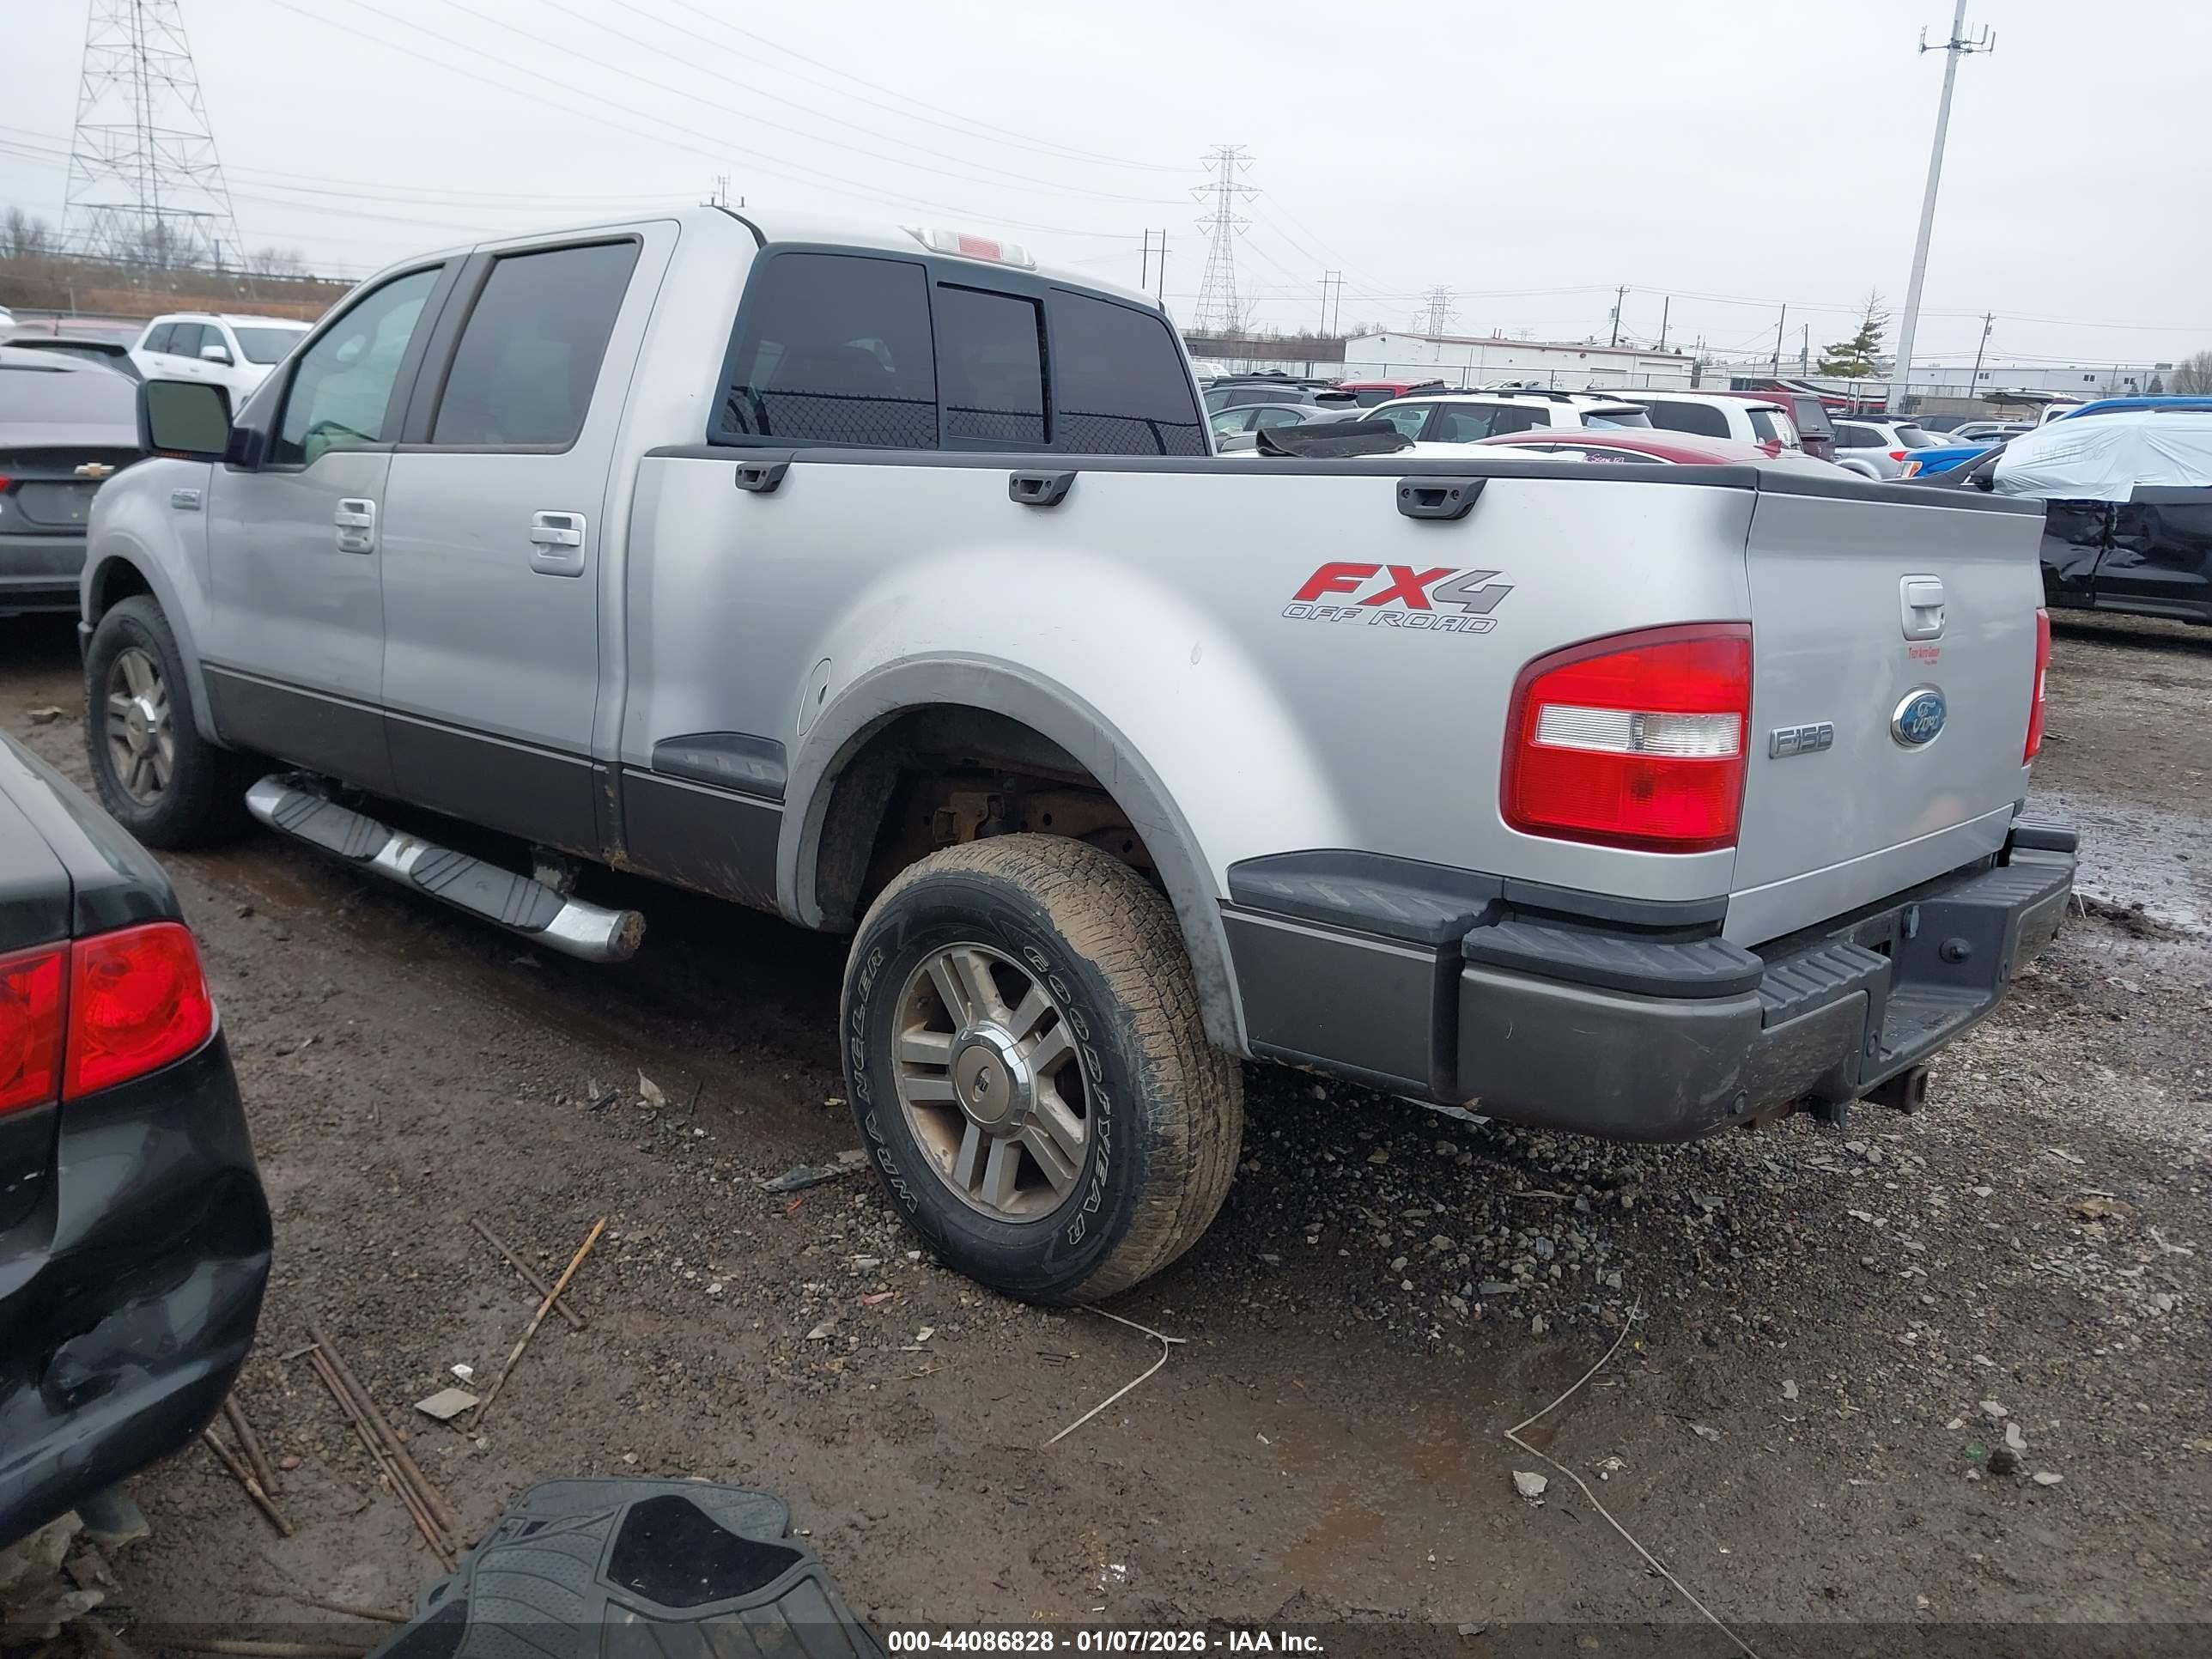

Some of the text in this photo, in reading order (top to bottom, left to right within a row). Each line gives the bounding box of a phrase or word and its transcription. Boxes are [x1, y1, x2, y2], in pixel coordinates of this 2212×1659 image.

[1292, 562, 1515, 614] FX4
[1282, 604, 1498, 634] OFF ROAD
[1912, 701, 1942, 733] Ford
[1023, 946, 1112, 1246] GOODYEAR
